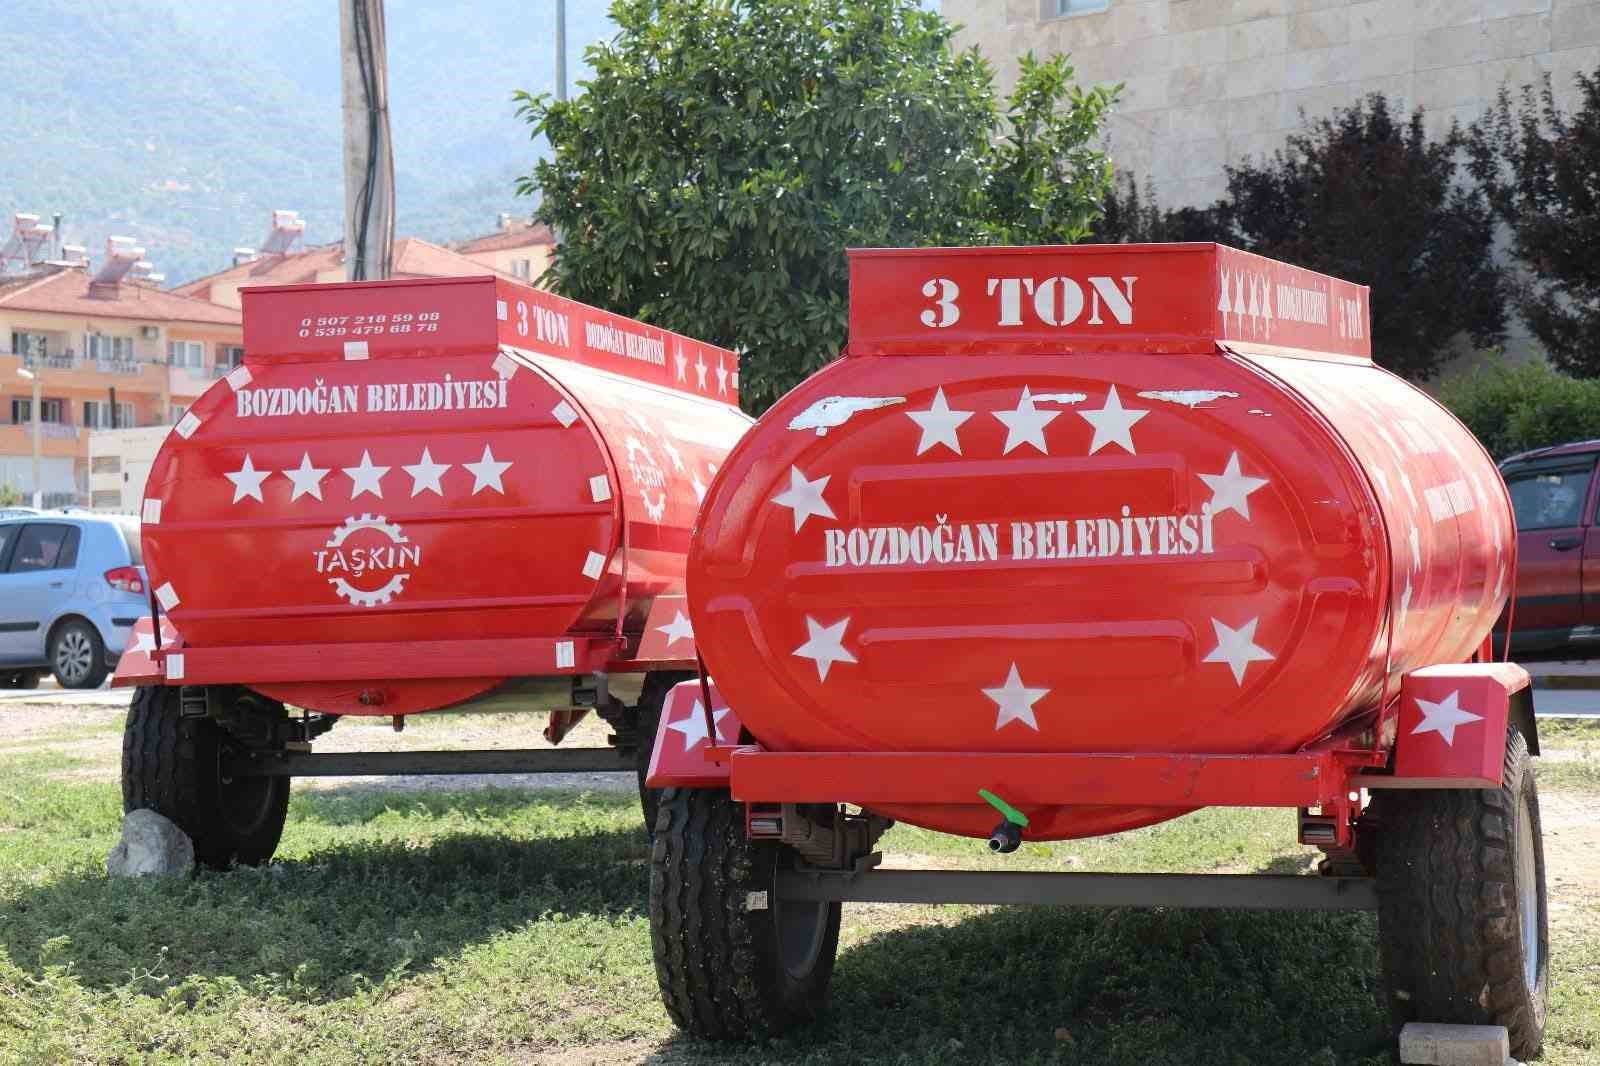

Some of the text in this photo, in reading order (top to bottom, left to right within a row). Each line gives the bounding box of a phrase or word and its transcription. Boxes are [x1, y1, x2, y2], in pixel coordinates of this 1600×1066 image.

[301, 312, 440, 327] 0 507 218 59 08
[920, 276, 1139, 328] 3 TON
[299, 323, 438, 337] 0 539 479 68 78
[516, 300, 569, 348] 3 TON
[236, 377, 358, 417] BOZDOĞAN
[824, 502, 1215, 567] BOZDOĞAN BELEDİYESİ
[312, 545, 421, 577] TAŞKIN
